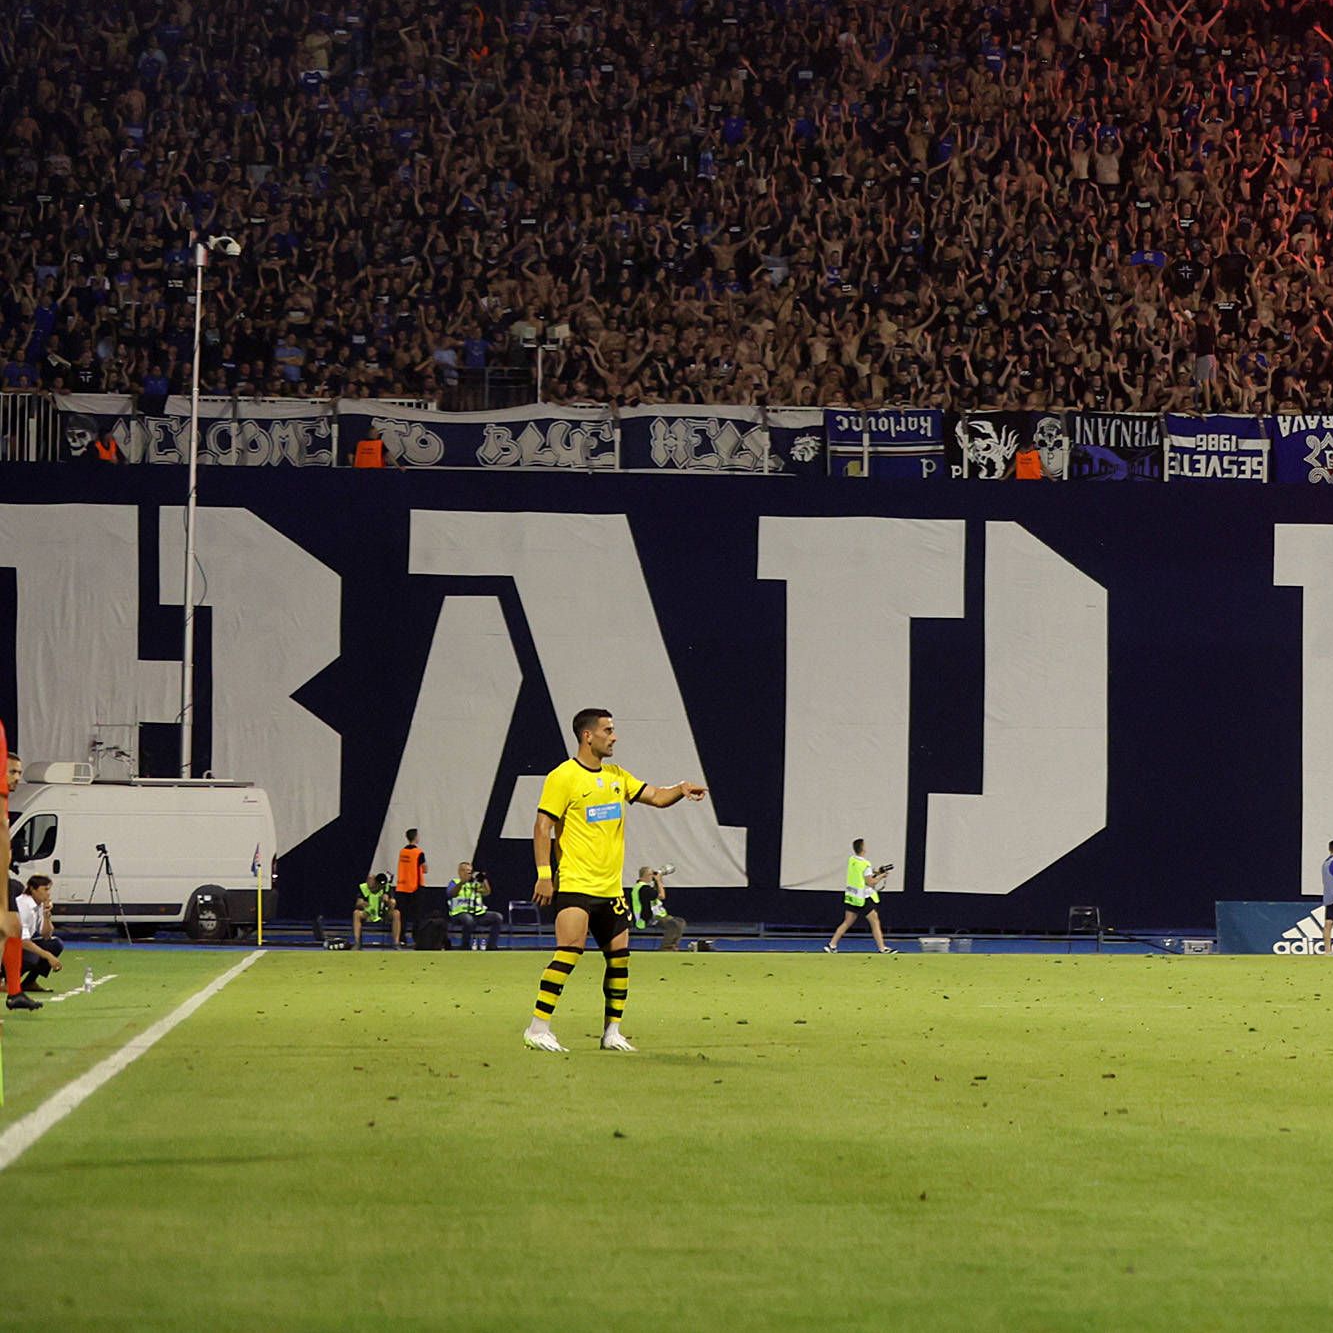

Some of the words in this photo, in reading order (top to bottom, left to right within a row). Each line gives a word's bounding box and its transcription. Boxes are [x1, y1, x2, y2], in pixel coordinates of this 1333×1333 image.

[1196, 433, 1238, 452] 1986
[1168, 451, 1264, 480] SESVETE
[0, 503, 1108, 895] BAD
